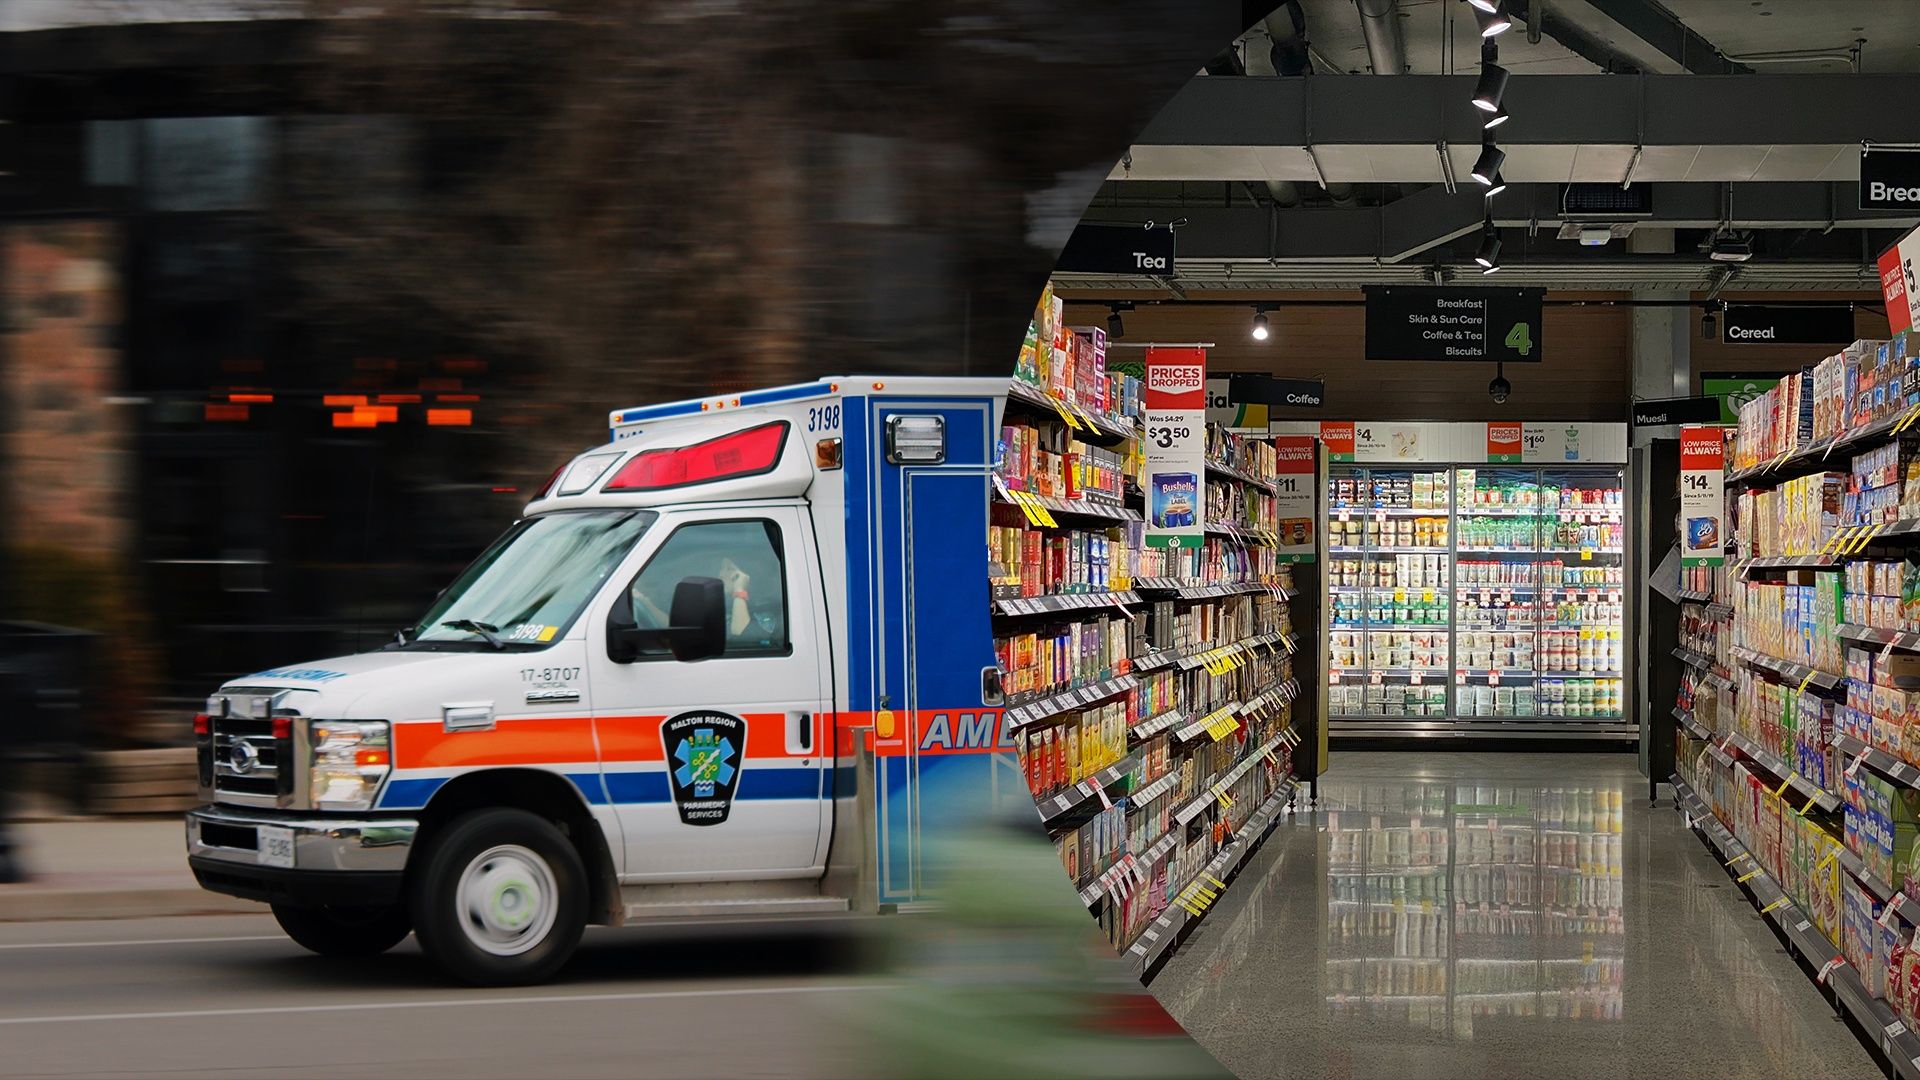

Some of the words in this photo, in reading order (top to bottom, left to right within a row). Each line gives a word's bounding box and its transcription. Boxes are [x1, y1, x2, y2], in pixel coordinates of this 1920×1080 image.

[1133, 252, 1166, 269] Tea
[1437, 299, 1482, 308] Breakfast
[1409, 314, 1428, 323] Skin
[1430, 315, 1438, 323] &
[1440, 315, 1458, 324] Sun
[1460, 316, 1482, 324] Care
[1422, 331, 1454, 339] Coffee
[1455, 331, 1462, 339] &
[1464, 331, 1482, 340] Tea
[1729, 326, 1775, 339] Cereal
[1505, 322, 1532, 356] 4
[1446, 347, 1482, 356] Biscuits
[1151, 368, 1200, 378] PRICES
[1287, 394, 1320, 405] Coffee
[809, 405, 840, 432] 3198
[1636, 414, 1667, 423] Muesli
[1357, 429, 1371, 441] $4
[1278, 452, 1313, 460] ALWAYS
[1683, 447, 1721, 455] ALWAYS
[1162, 481, 1195, 493] Bushells
[1279, 478, 1296, 491] $11
[1684, 475, 1708, 489] $14
[509, 624, 544, 640] 3198
[520, 667, 580, 681] 17-8707
[671, 717, 703, 730] HALTON
[705, 716, 737, 728] REGION
[684, 801, 726, 810] PARAMEDIC
[688, 810, 722, 819] SERVICES
